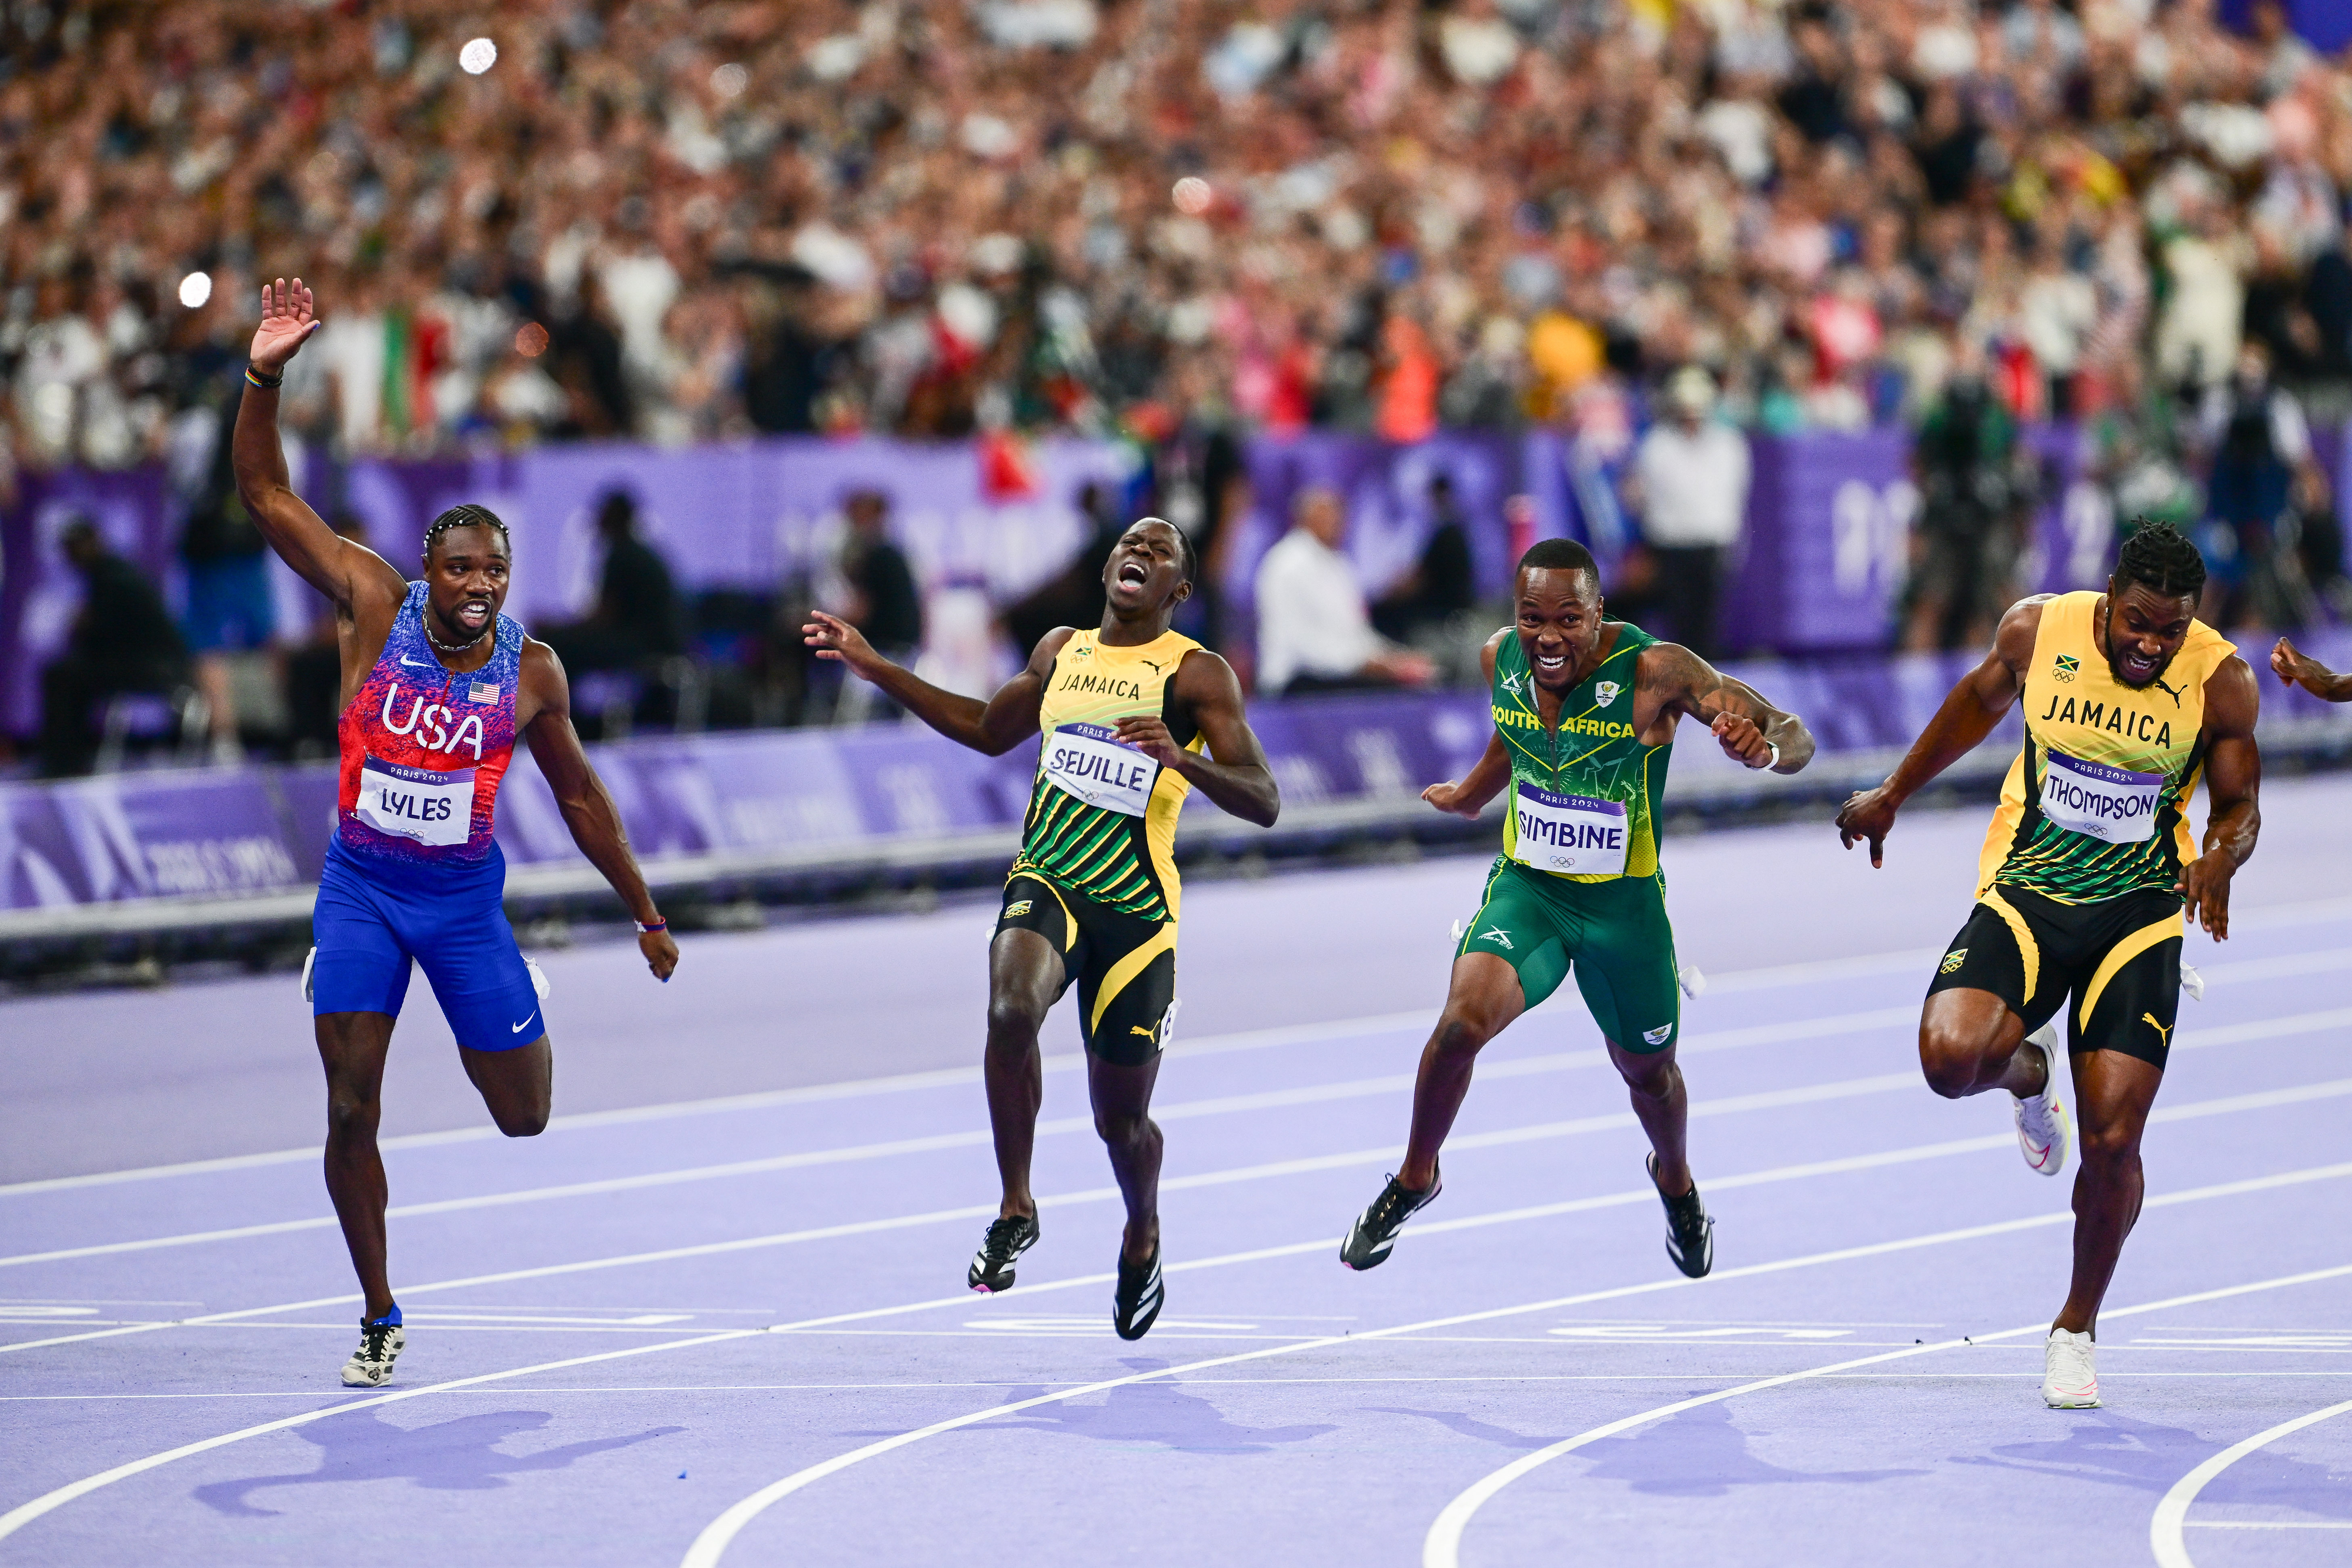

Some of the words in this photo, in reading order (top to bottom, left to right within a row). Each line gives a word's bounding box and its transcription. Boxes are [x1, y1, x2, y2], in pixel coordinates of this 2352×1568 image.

[1059, 674, 1140, 701] JAMAICA
[382, 683, 483, 760] USA
[1077, 724, 1104, 738] PARIS
[1491, 704, 1539, 730] SOUTH
[1561, 717, 1636, 738] AFRICA
[2042, 695, 2170, 750] JAMAICA
[390, 767, 419, 779] PARIS
[422, 774, 449, 783] 2024
[1050, 748, 1147, 792] SEVILLE
[2074, 762, 2103, 776] PARIS
[2107, 770, 2133, 783] 2024
[381, 788, 452, 821] LYLES
[1539, 793, 1568, 805] PARIS
[1571, 799, 1599, 809] 2024
[2049, 774, 2155, 820] THOMPSON
[1518, 810, 1623, 850] SIMBINE
